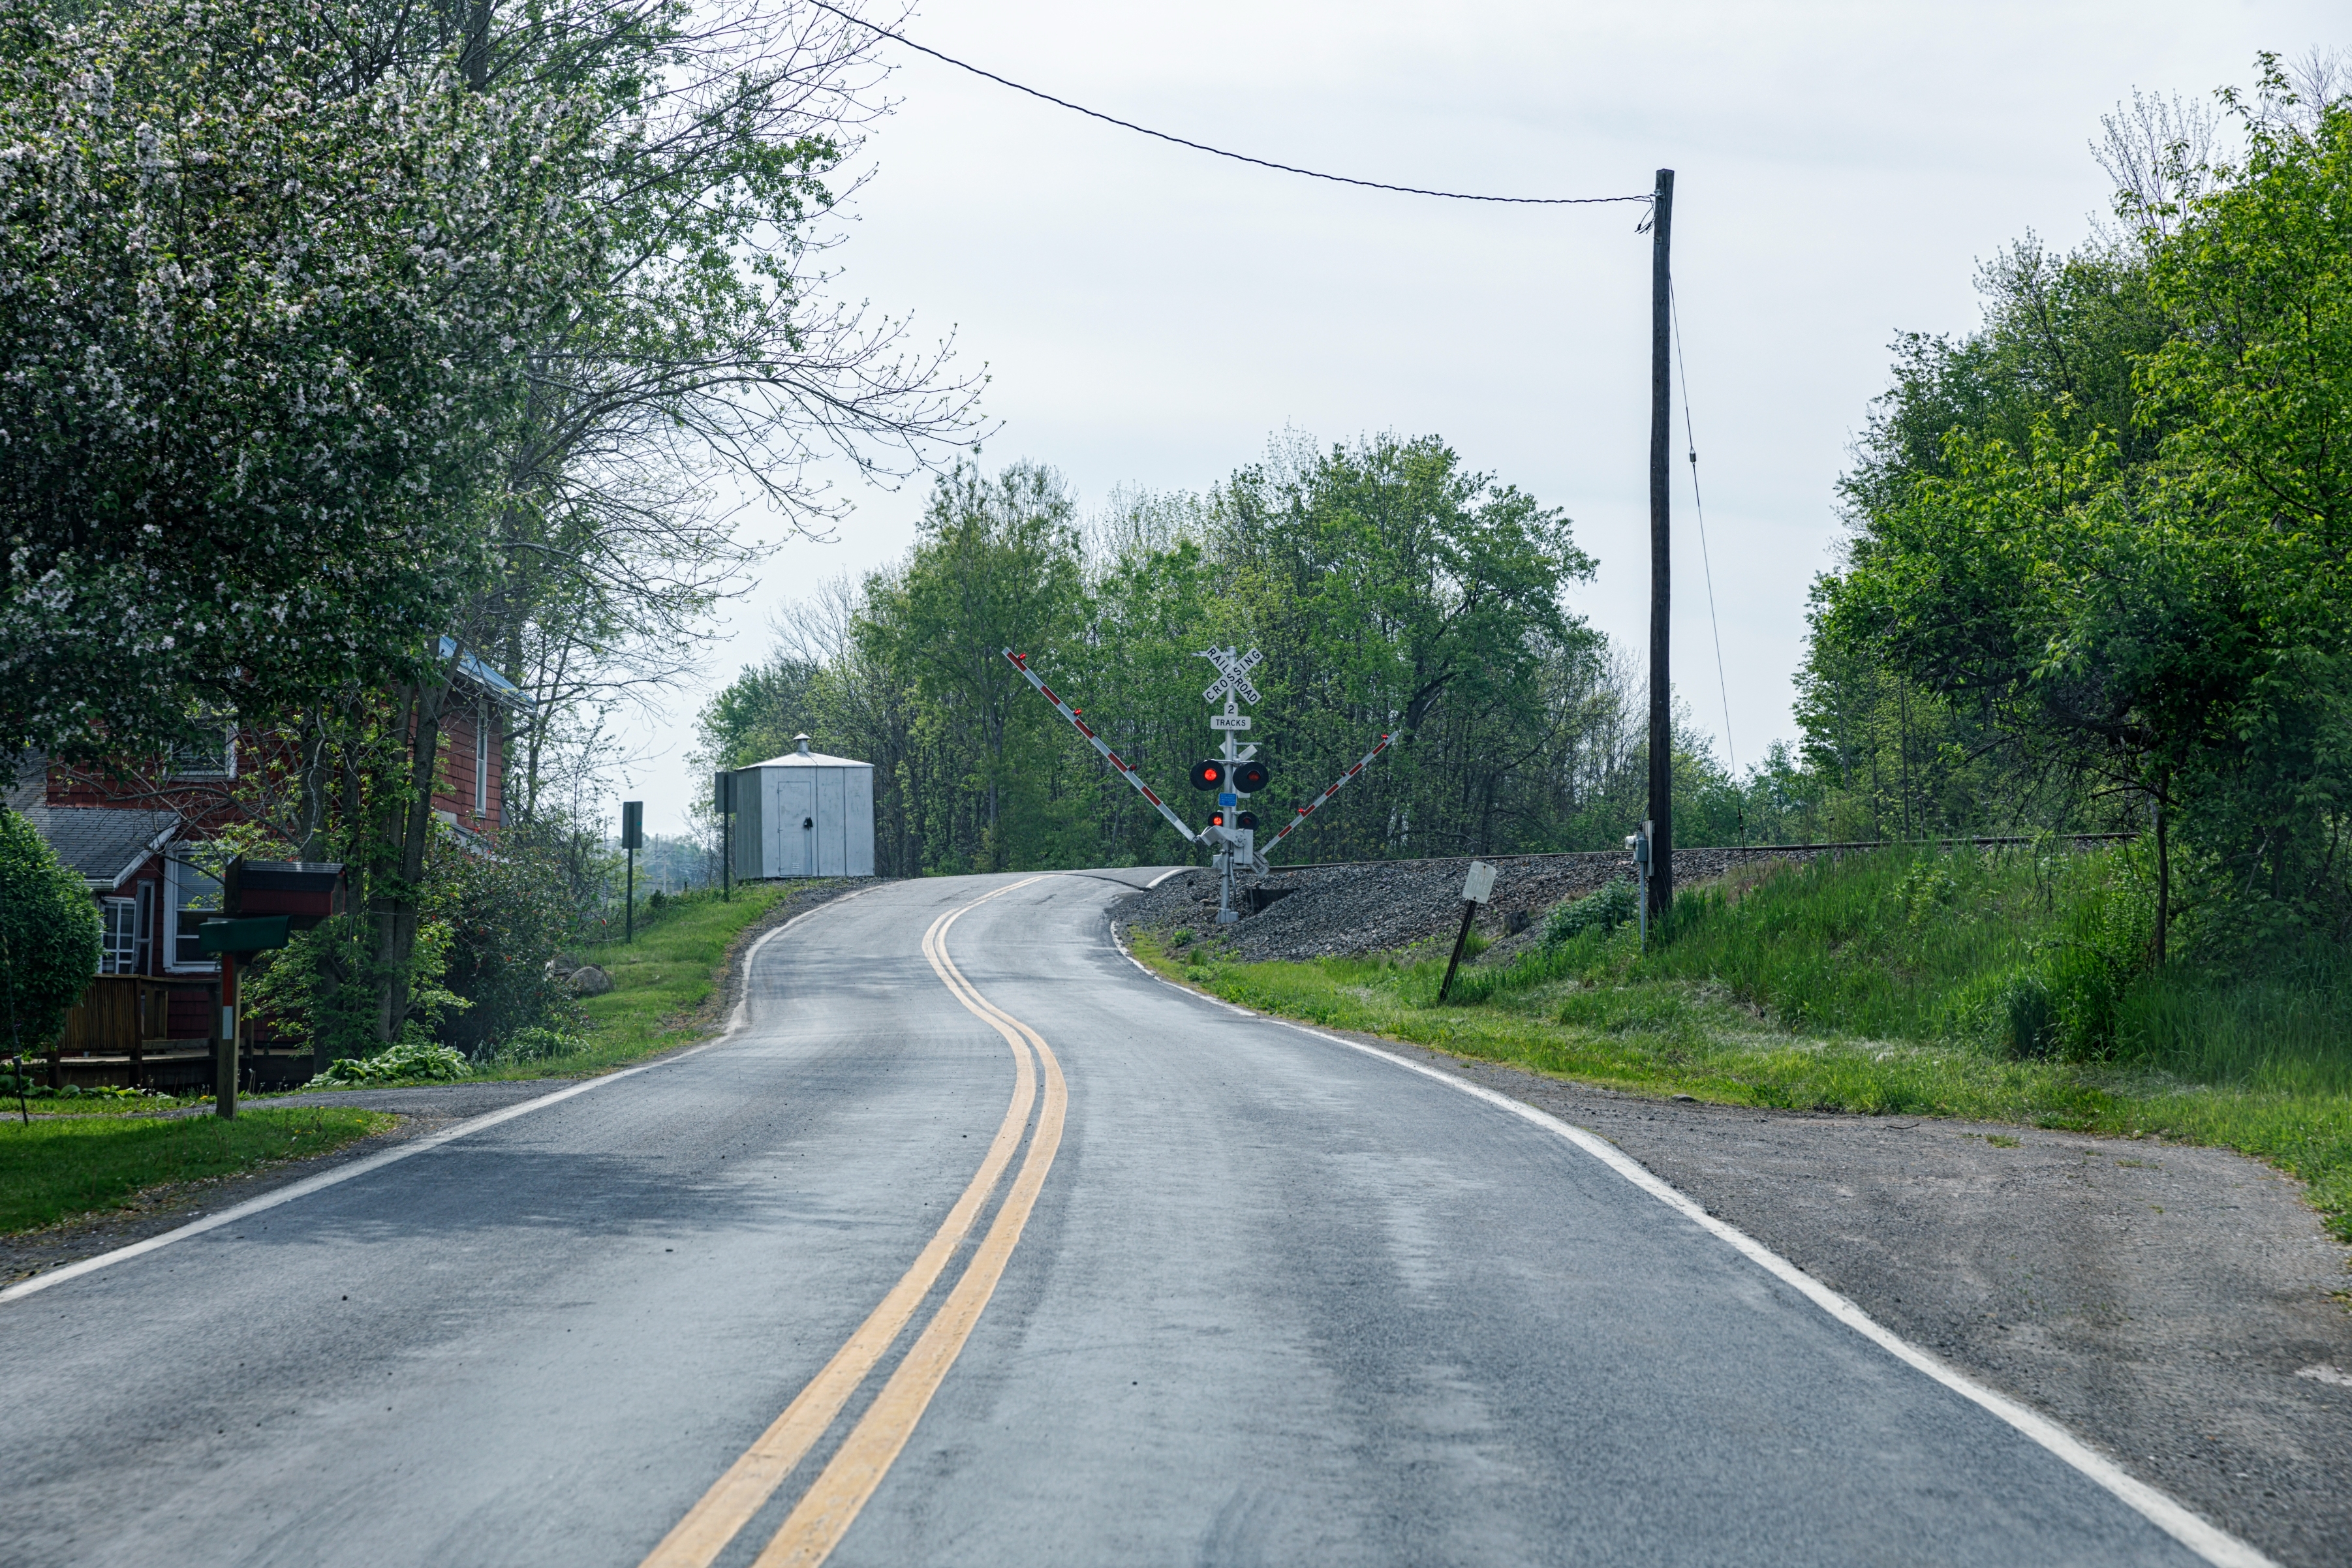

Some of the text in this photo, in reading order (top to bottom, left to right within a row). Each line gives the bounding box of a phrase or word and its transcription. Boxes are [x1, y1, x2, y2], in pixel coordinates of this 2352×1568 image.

[1206, 651, 1260, 700] CROSSING
[1207, 648, 1258, 702] RAIL ROAD
[1228, 705, 1234, 714] 2
[1473, 874, 1489, 884] ANY
[1470, 881, 1487, 893] TIME
